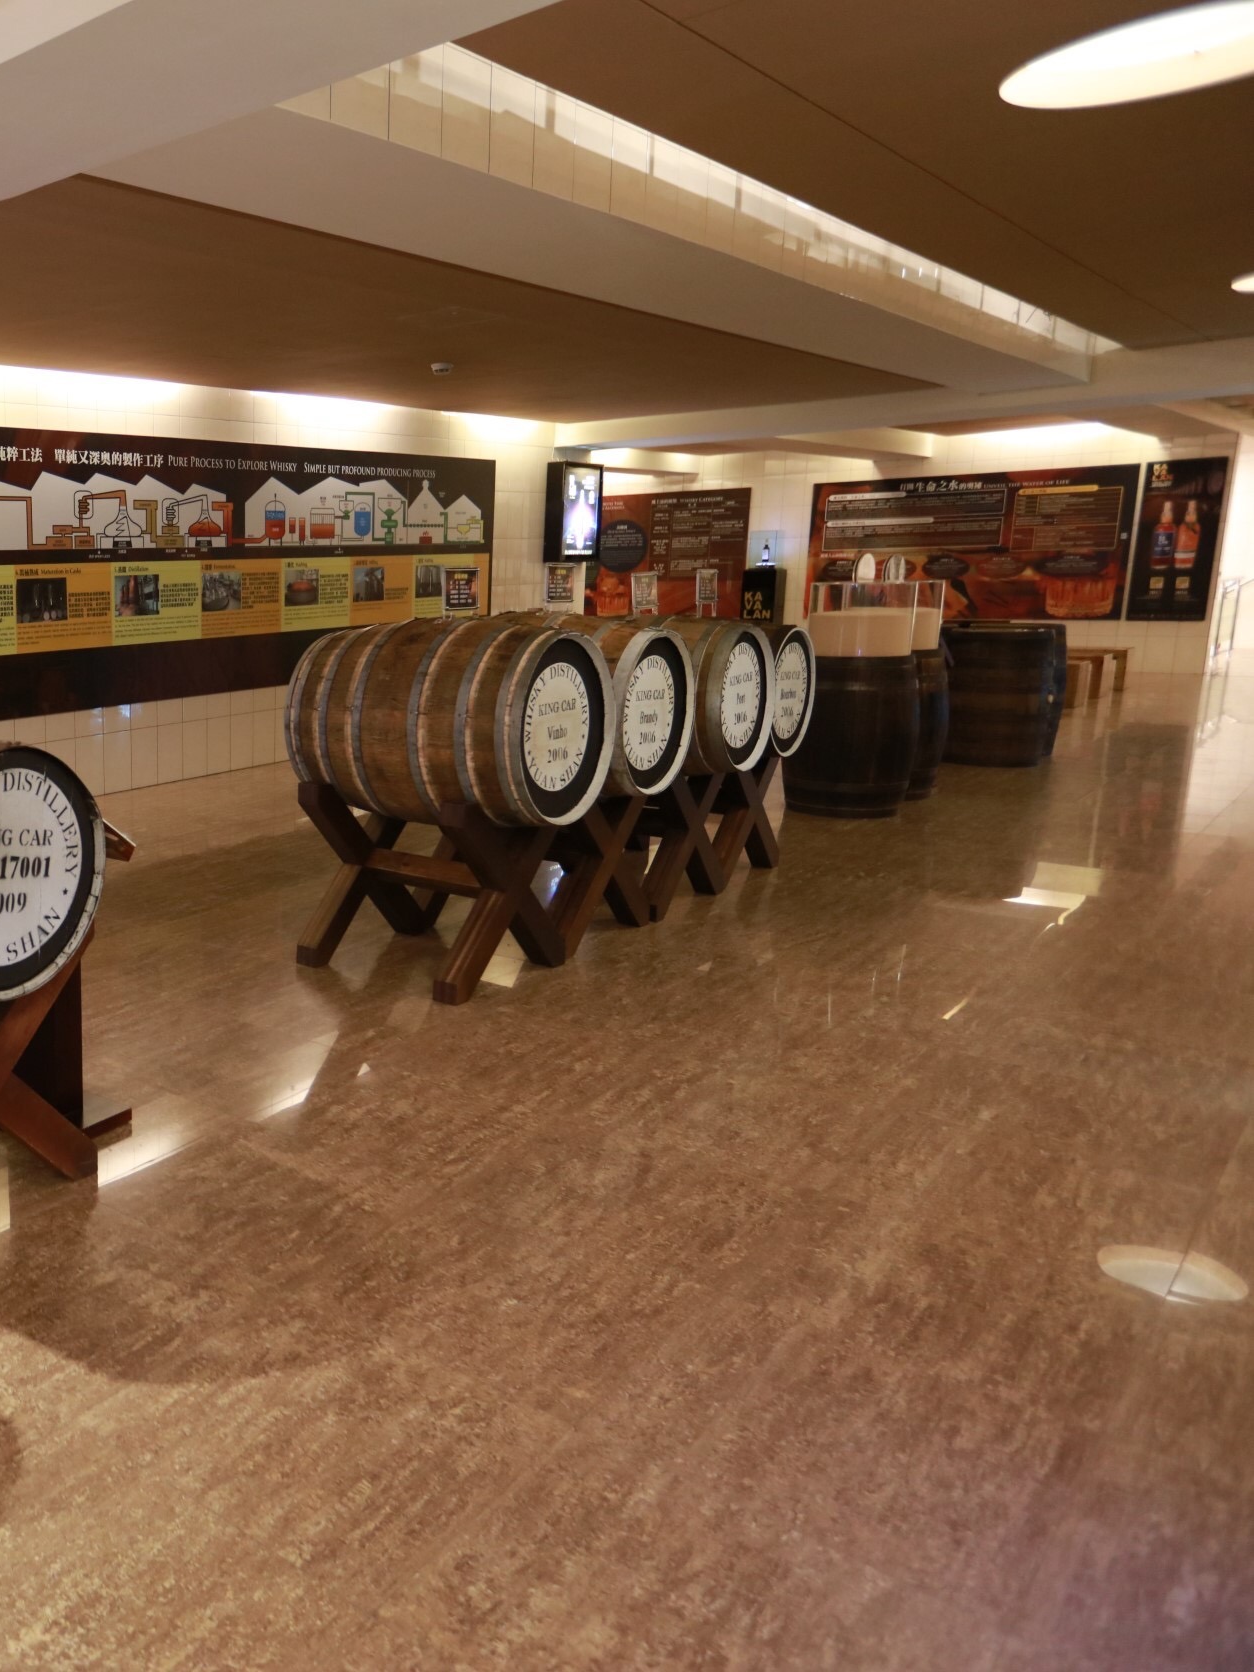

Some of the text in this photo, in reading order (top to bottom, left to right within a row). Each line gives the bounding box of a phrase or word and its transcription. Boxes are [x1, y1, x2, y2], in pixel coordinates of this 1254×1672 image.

[54, 448, 164, 468] 單純又深奧的製作工序
[744, 591, 762, 601] KA
[744, 600, 762, 609] VA
[743, 609, 770, 619] LAN
[635, 688, 665, 701] KING CAR
[525, 664, 588, 743] WHISKY DISTILLERY
[538, 698, 576, 717] KING CAR
[639, 709, 658, 725] Brandy
[547, 724, 568, 740] Vinho
[639, 730, 656, 745] 2006
[547, 746, 568, 763] 2006
[625, 734, 668, 768] YUAN SHAN
[528, 746, 583, 789] YUAN SHAN
[2, 771, 77, 879] DISTILLERY
[19, 829, 54, 847] CAR
[6, 906, 61, 963] SHAN
